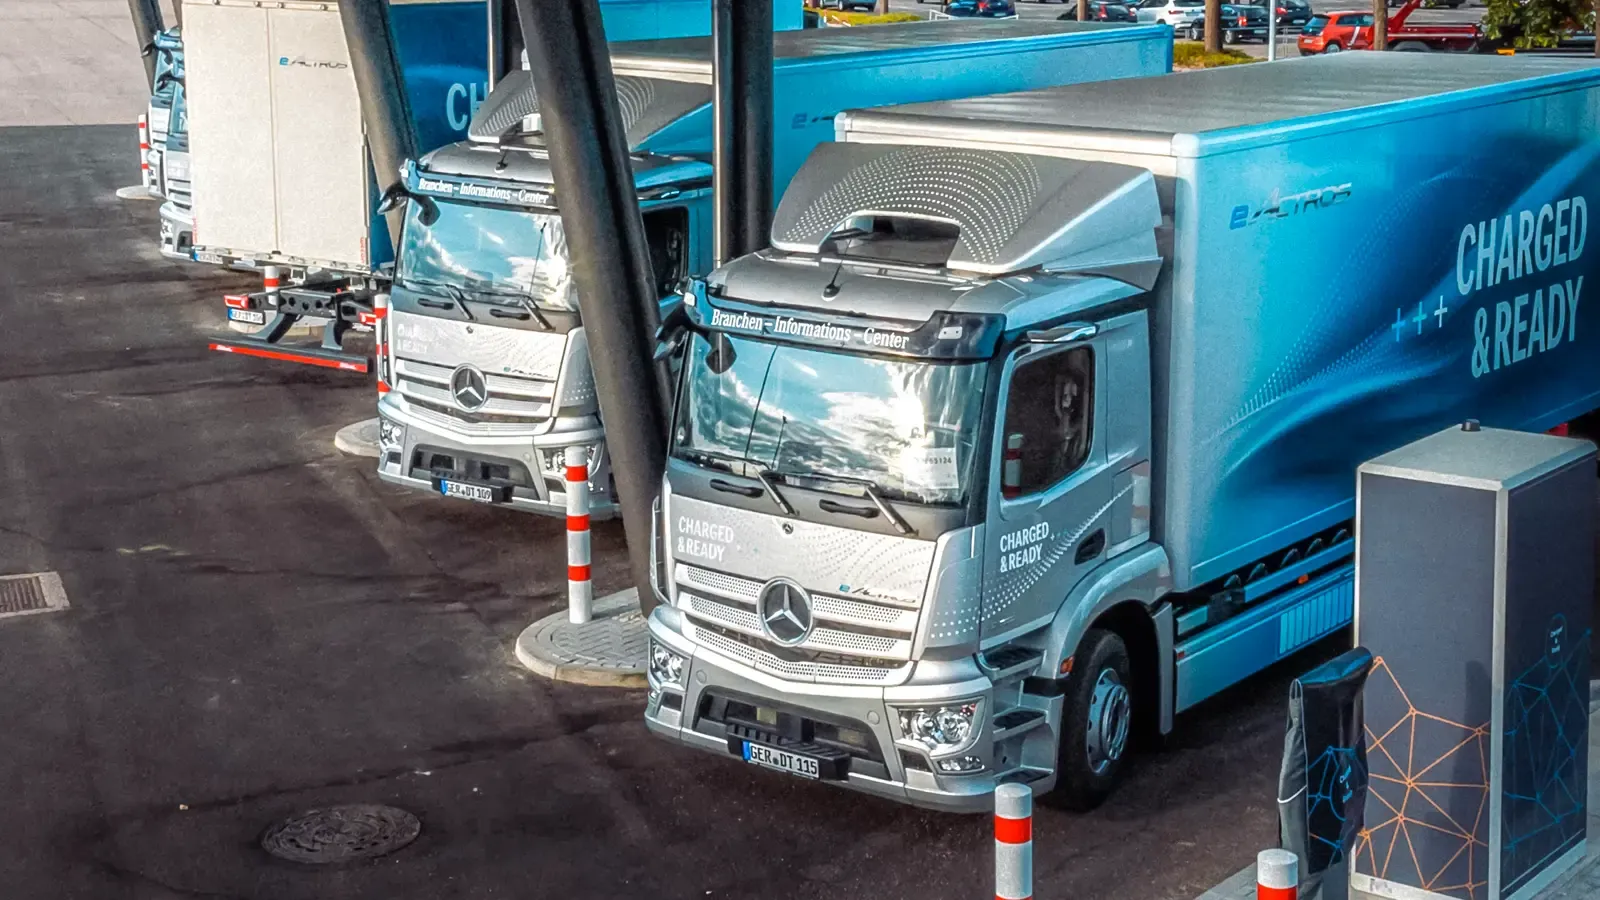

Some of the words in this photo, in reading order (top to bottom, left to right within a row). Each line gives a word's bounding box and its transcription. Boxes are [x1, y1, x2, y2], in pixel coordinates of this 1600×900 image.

[418, 177, 453, 194] Branchen
[459, 182, 511, 201] Informations
[518, 188, 549, 204] Center
[1456, 196, 1588, 296] CHARGED
[710, 308, 763, 331] Branchen
[773, 315, 852, 343] Informations
[863, 326, 910, 349] Center
[678, 515, 735, 544] CHARGED
[1000, 521, 1050, 553] CHARGED
[750, 745, 772, 764] GER
[779, 752, 794, 769] DT
[796, 757, 818, 775] 115
